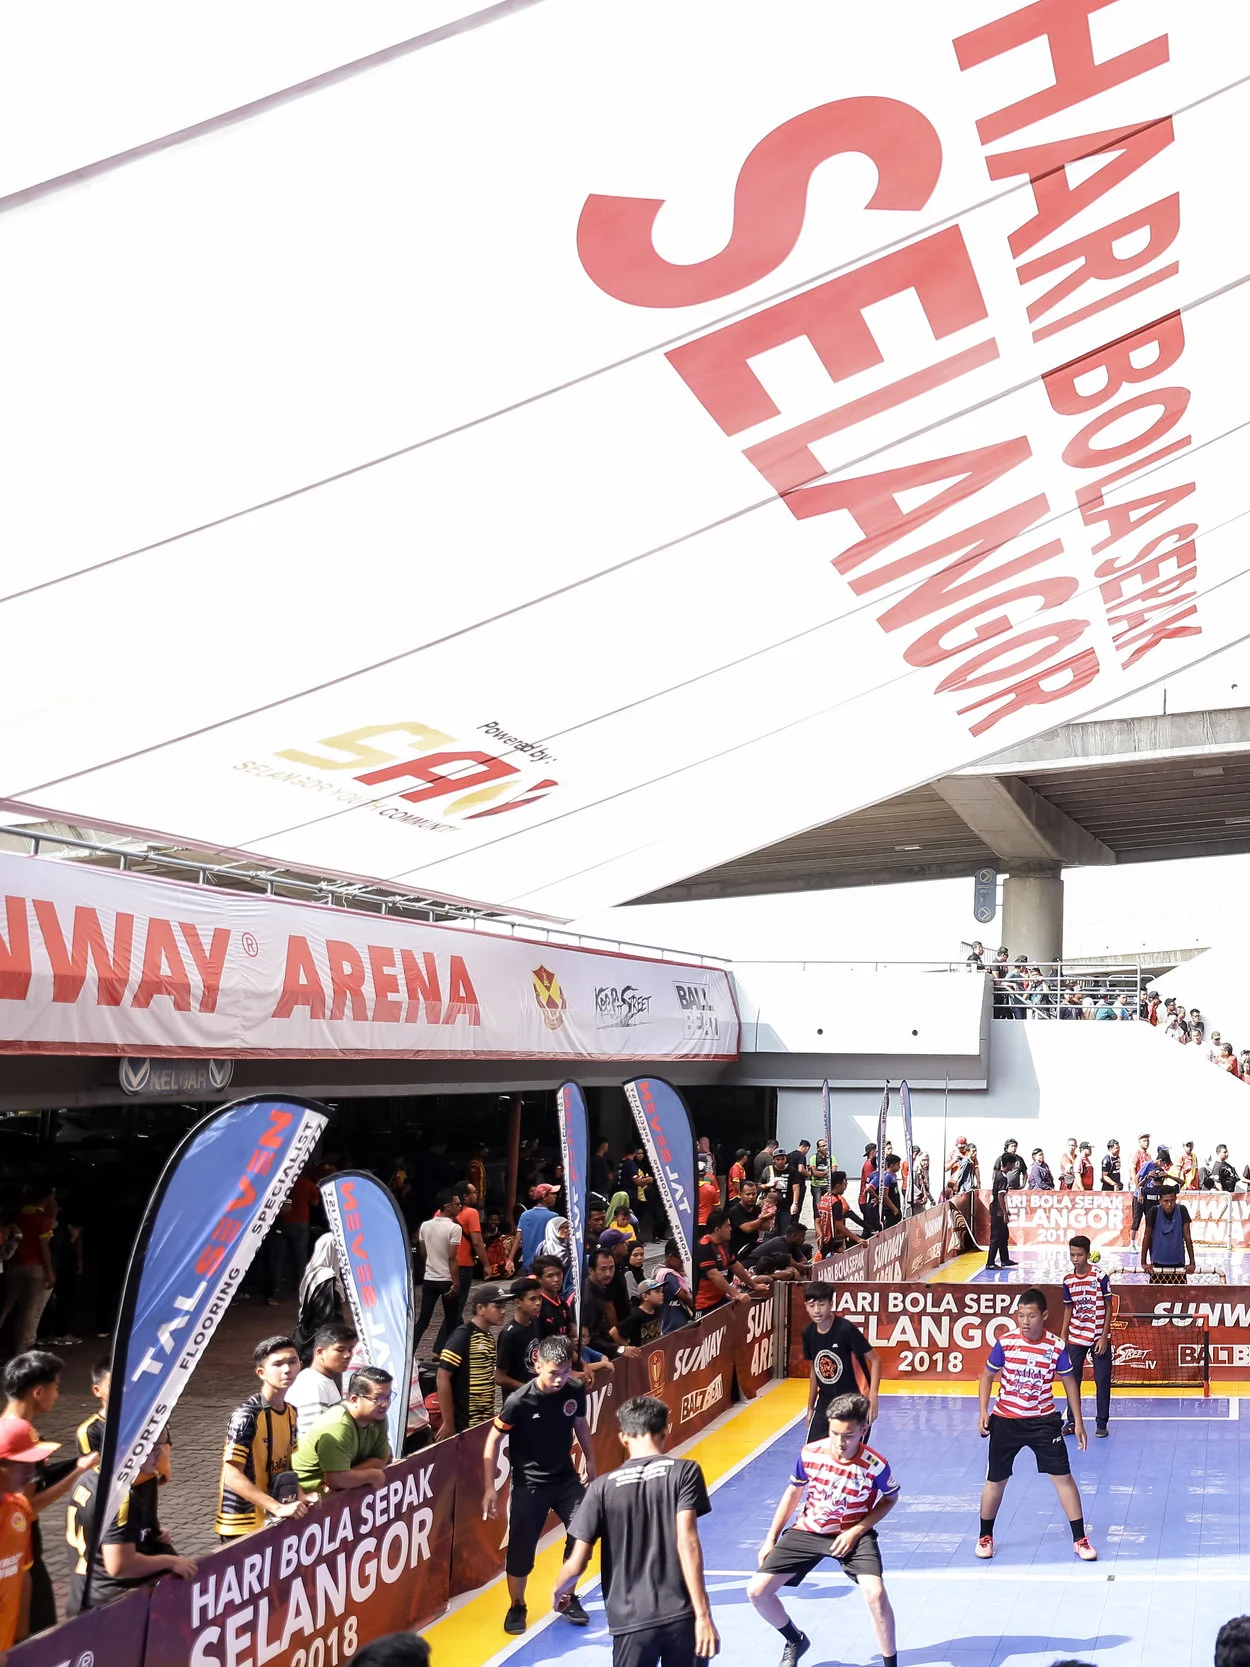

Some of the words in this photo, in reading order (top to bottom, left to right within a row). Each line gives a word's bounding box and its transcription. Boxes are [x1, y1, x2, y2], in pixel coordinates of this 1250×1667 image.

[952, 0, 1181, 344] HARI
[576, 95, 1101, 738] SELANGOR
[1041, 310, 1198, 556] BOLA
[1093, 522, 1203, 671] SEPAK
[476, 720, 536, 752] Powered
[271, 934, 481, 1026] ARENA
[150, 1069, 206, 1090] KELUAR
[1007, 1208, 1124, 1229] ELANGOR
[1031, 1195, 1072, 1208] BOLA
[1074, 1196, 1124, 1210] SEPAK
[1190, 1221, 1245, 1242] ENA
[131, 1281, 209, 1383] TAL
[195, 1110, 294, 1278] SEVEN
[1037, 1227, 1076, 1243] 2018
[116, 1403, 168, 1484] SPORTS
[178, 1266, 241, 1371] FLOORING
[251, 1121, 314, 1236] SPECIALIST
[854, 1315, 1017, 1349] ELANGO
[887, 1291, 959, 1313] BOLA
[963, 1292, 1023, 1314] SEPA
[897, 1350, 963, 1374] 2018
[189, 1545, 273, 1630] HARI
[279, 1506, 355, 1581] BOLA
[358, 1462, 437, 1537] SEPAK
[189, 1507, 435, 1667] SELANGOR
